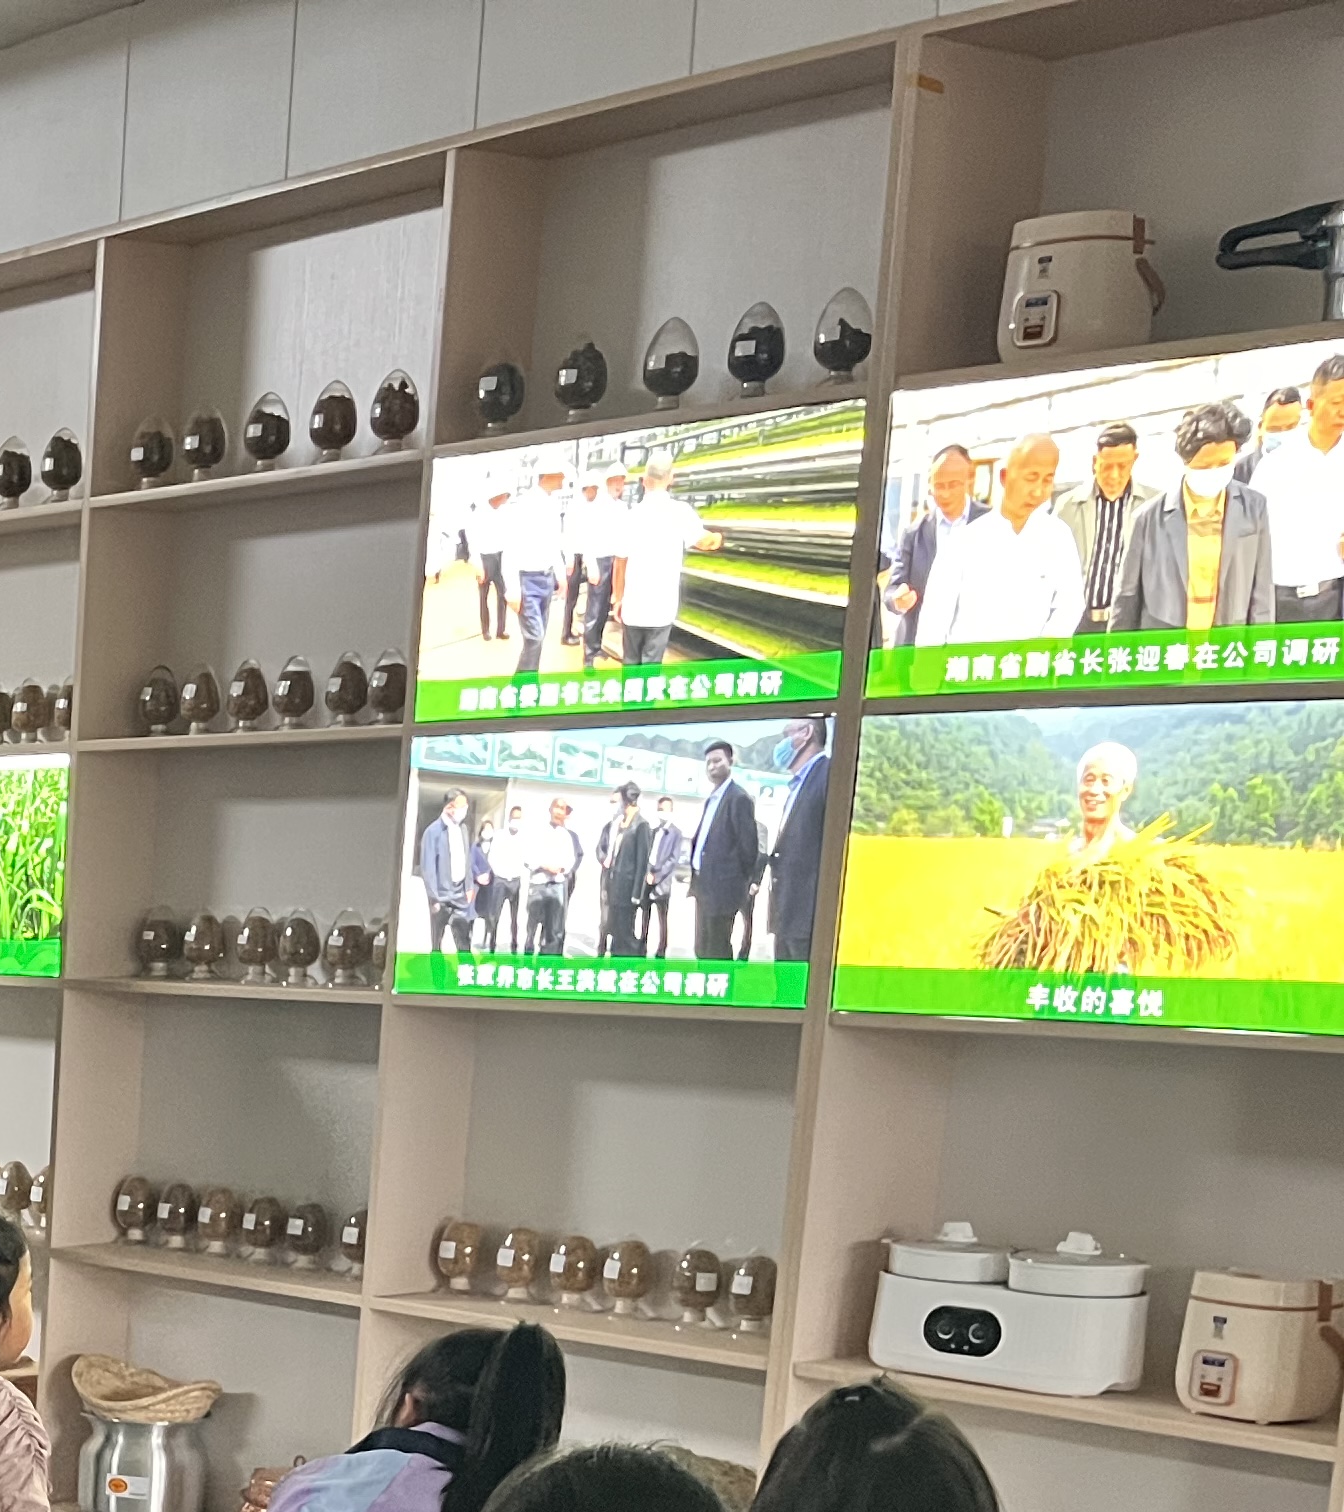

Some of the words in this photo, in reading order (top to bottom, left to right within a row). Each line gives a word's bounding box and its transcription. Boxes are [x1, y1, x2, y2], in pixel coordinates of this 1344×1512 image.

[945, 636, 1340, 682] 湖南省副省长张迎春在公司调研
[1026, 982, 1163, 1017] 丰收的喜悦
